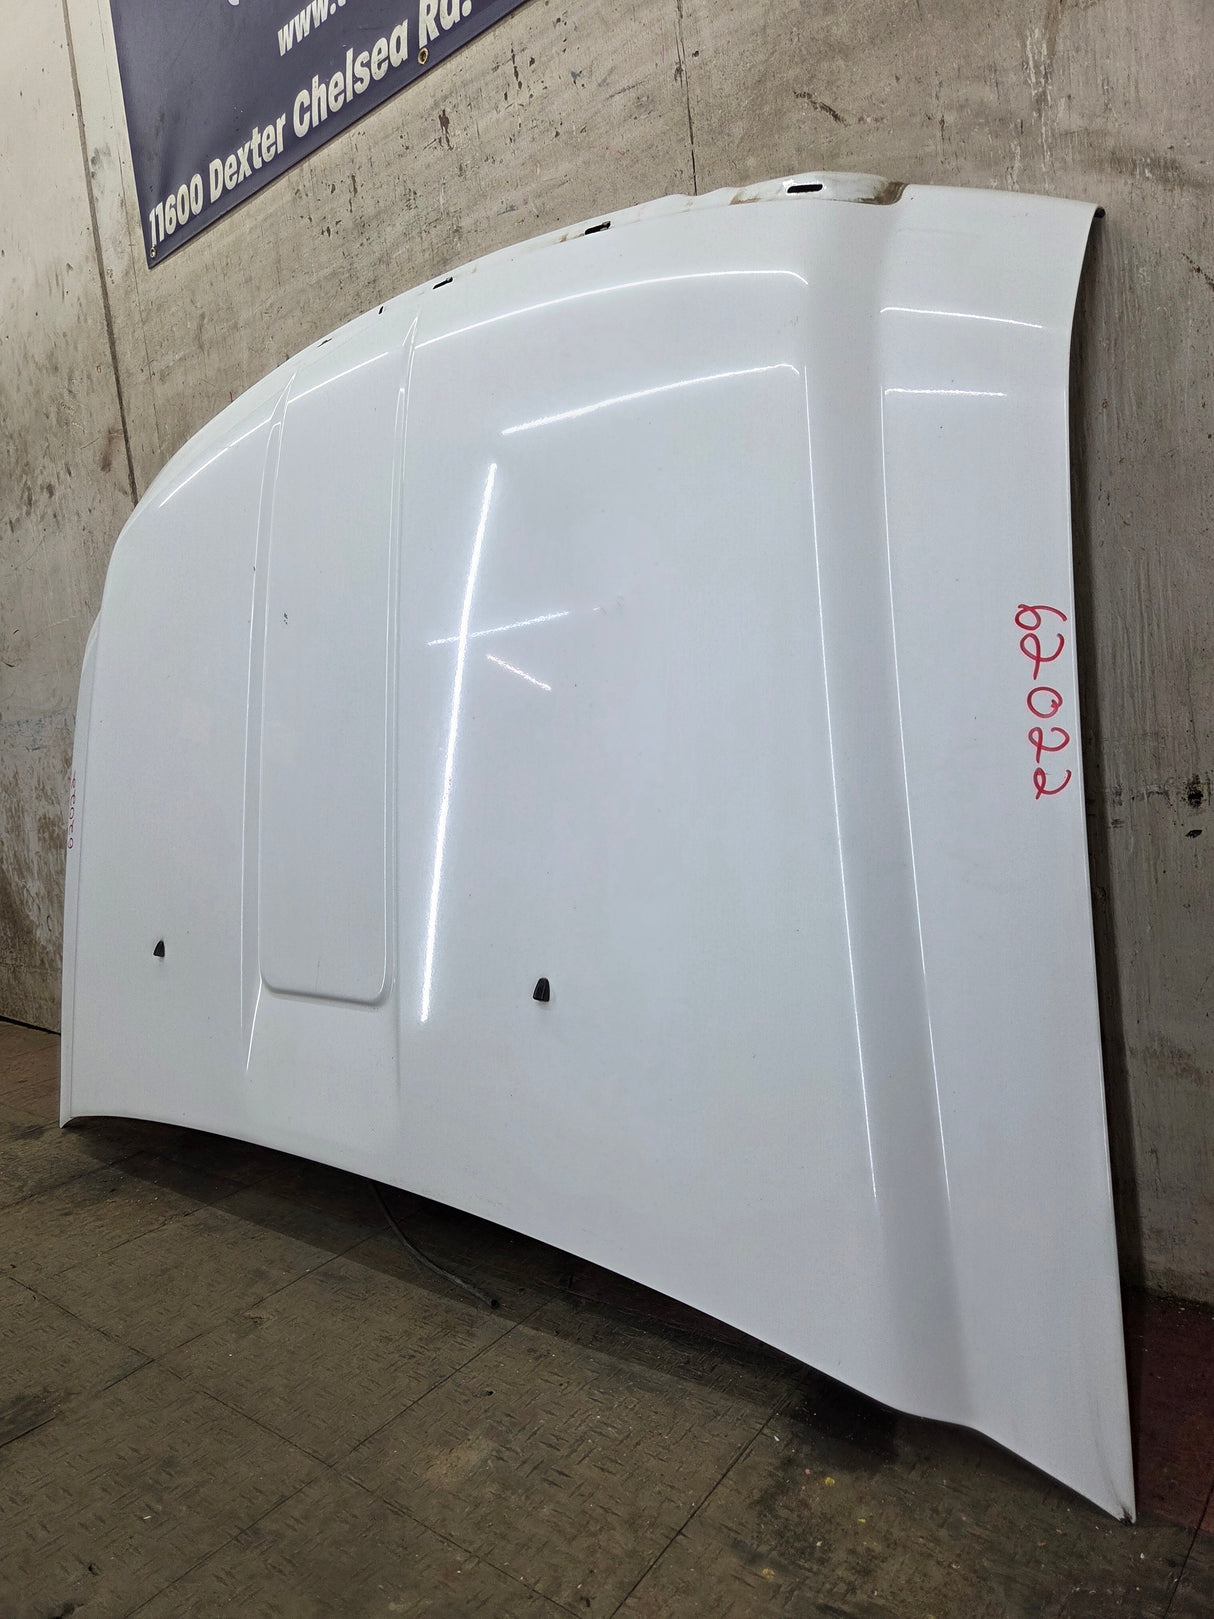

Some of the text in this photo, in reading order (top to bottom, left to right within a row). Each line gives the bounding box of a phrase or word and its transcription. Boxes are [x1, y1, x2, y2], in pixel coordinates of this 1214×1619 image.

[277, 0, 346, 57] www.
[149, 173, 204, 248] 11600
[209, 112, 286, 204] Dexter
[293, 18, 408, 138] Chelsea
[1014, 603, 1072, 800] 62022
